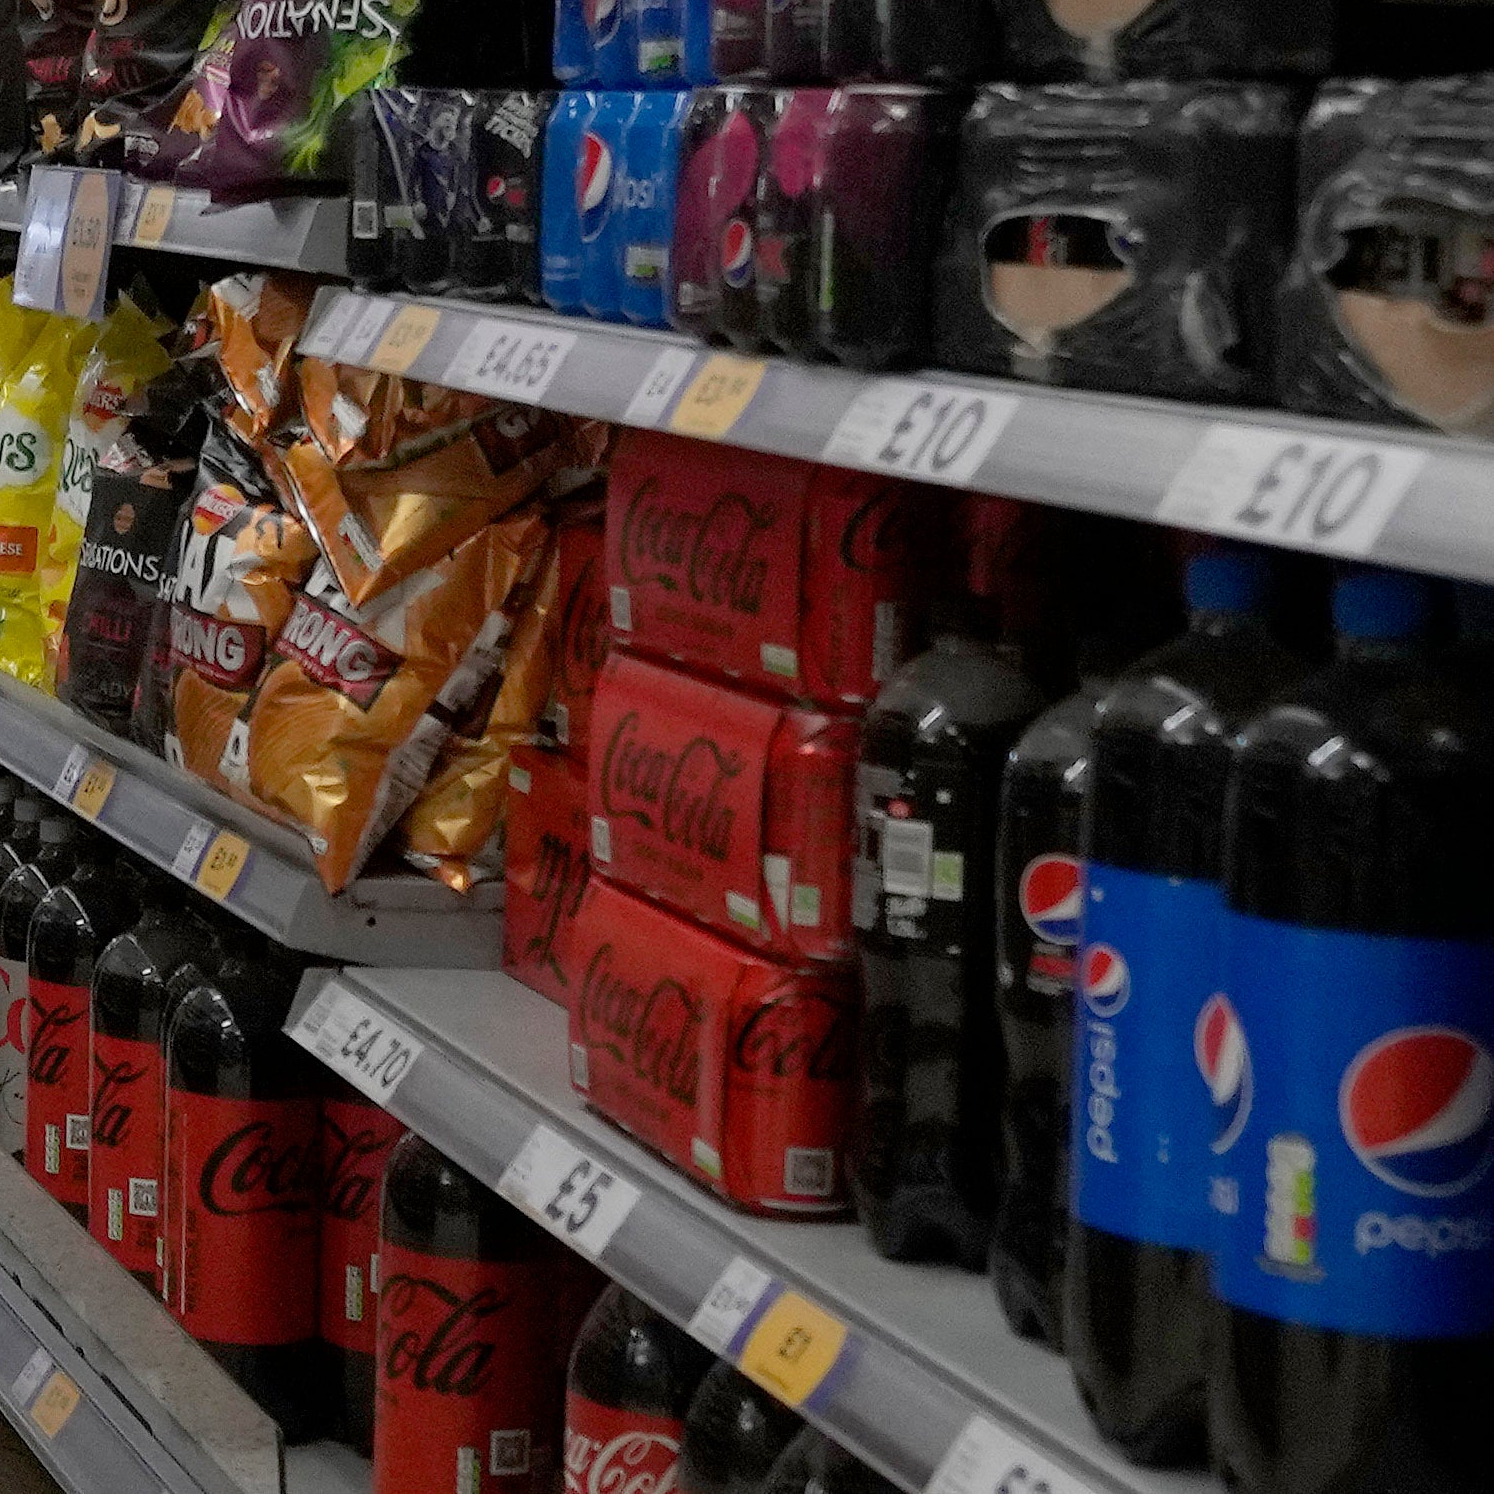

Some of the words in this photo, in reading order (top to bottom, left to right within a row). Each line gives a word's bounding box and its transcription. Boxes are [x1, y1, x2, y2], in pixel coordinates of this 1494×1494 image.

[476, 335, 551, 388] £4.65
[878, 391, 986, 472] £10
[1235, 444, 1380, 538] £10
[340, 1019, 410, 1090] £4.70
[1087, 1020, 1120, 1165] pepsi
[545, 1158, 613, 1234] £5
